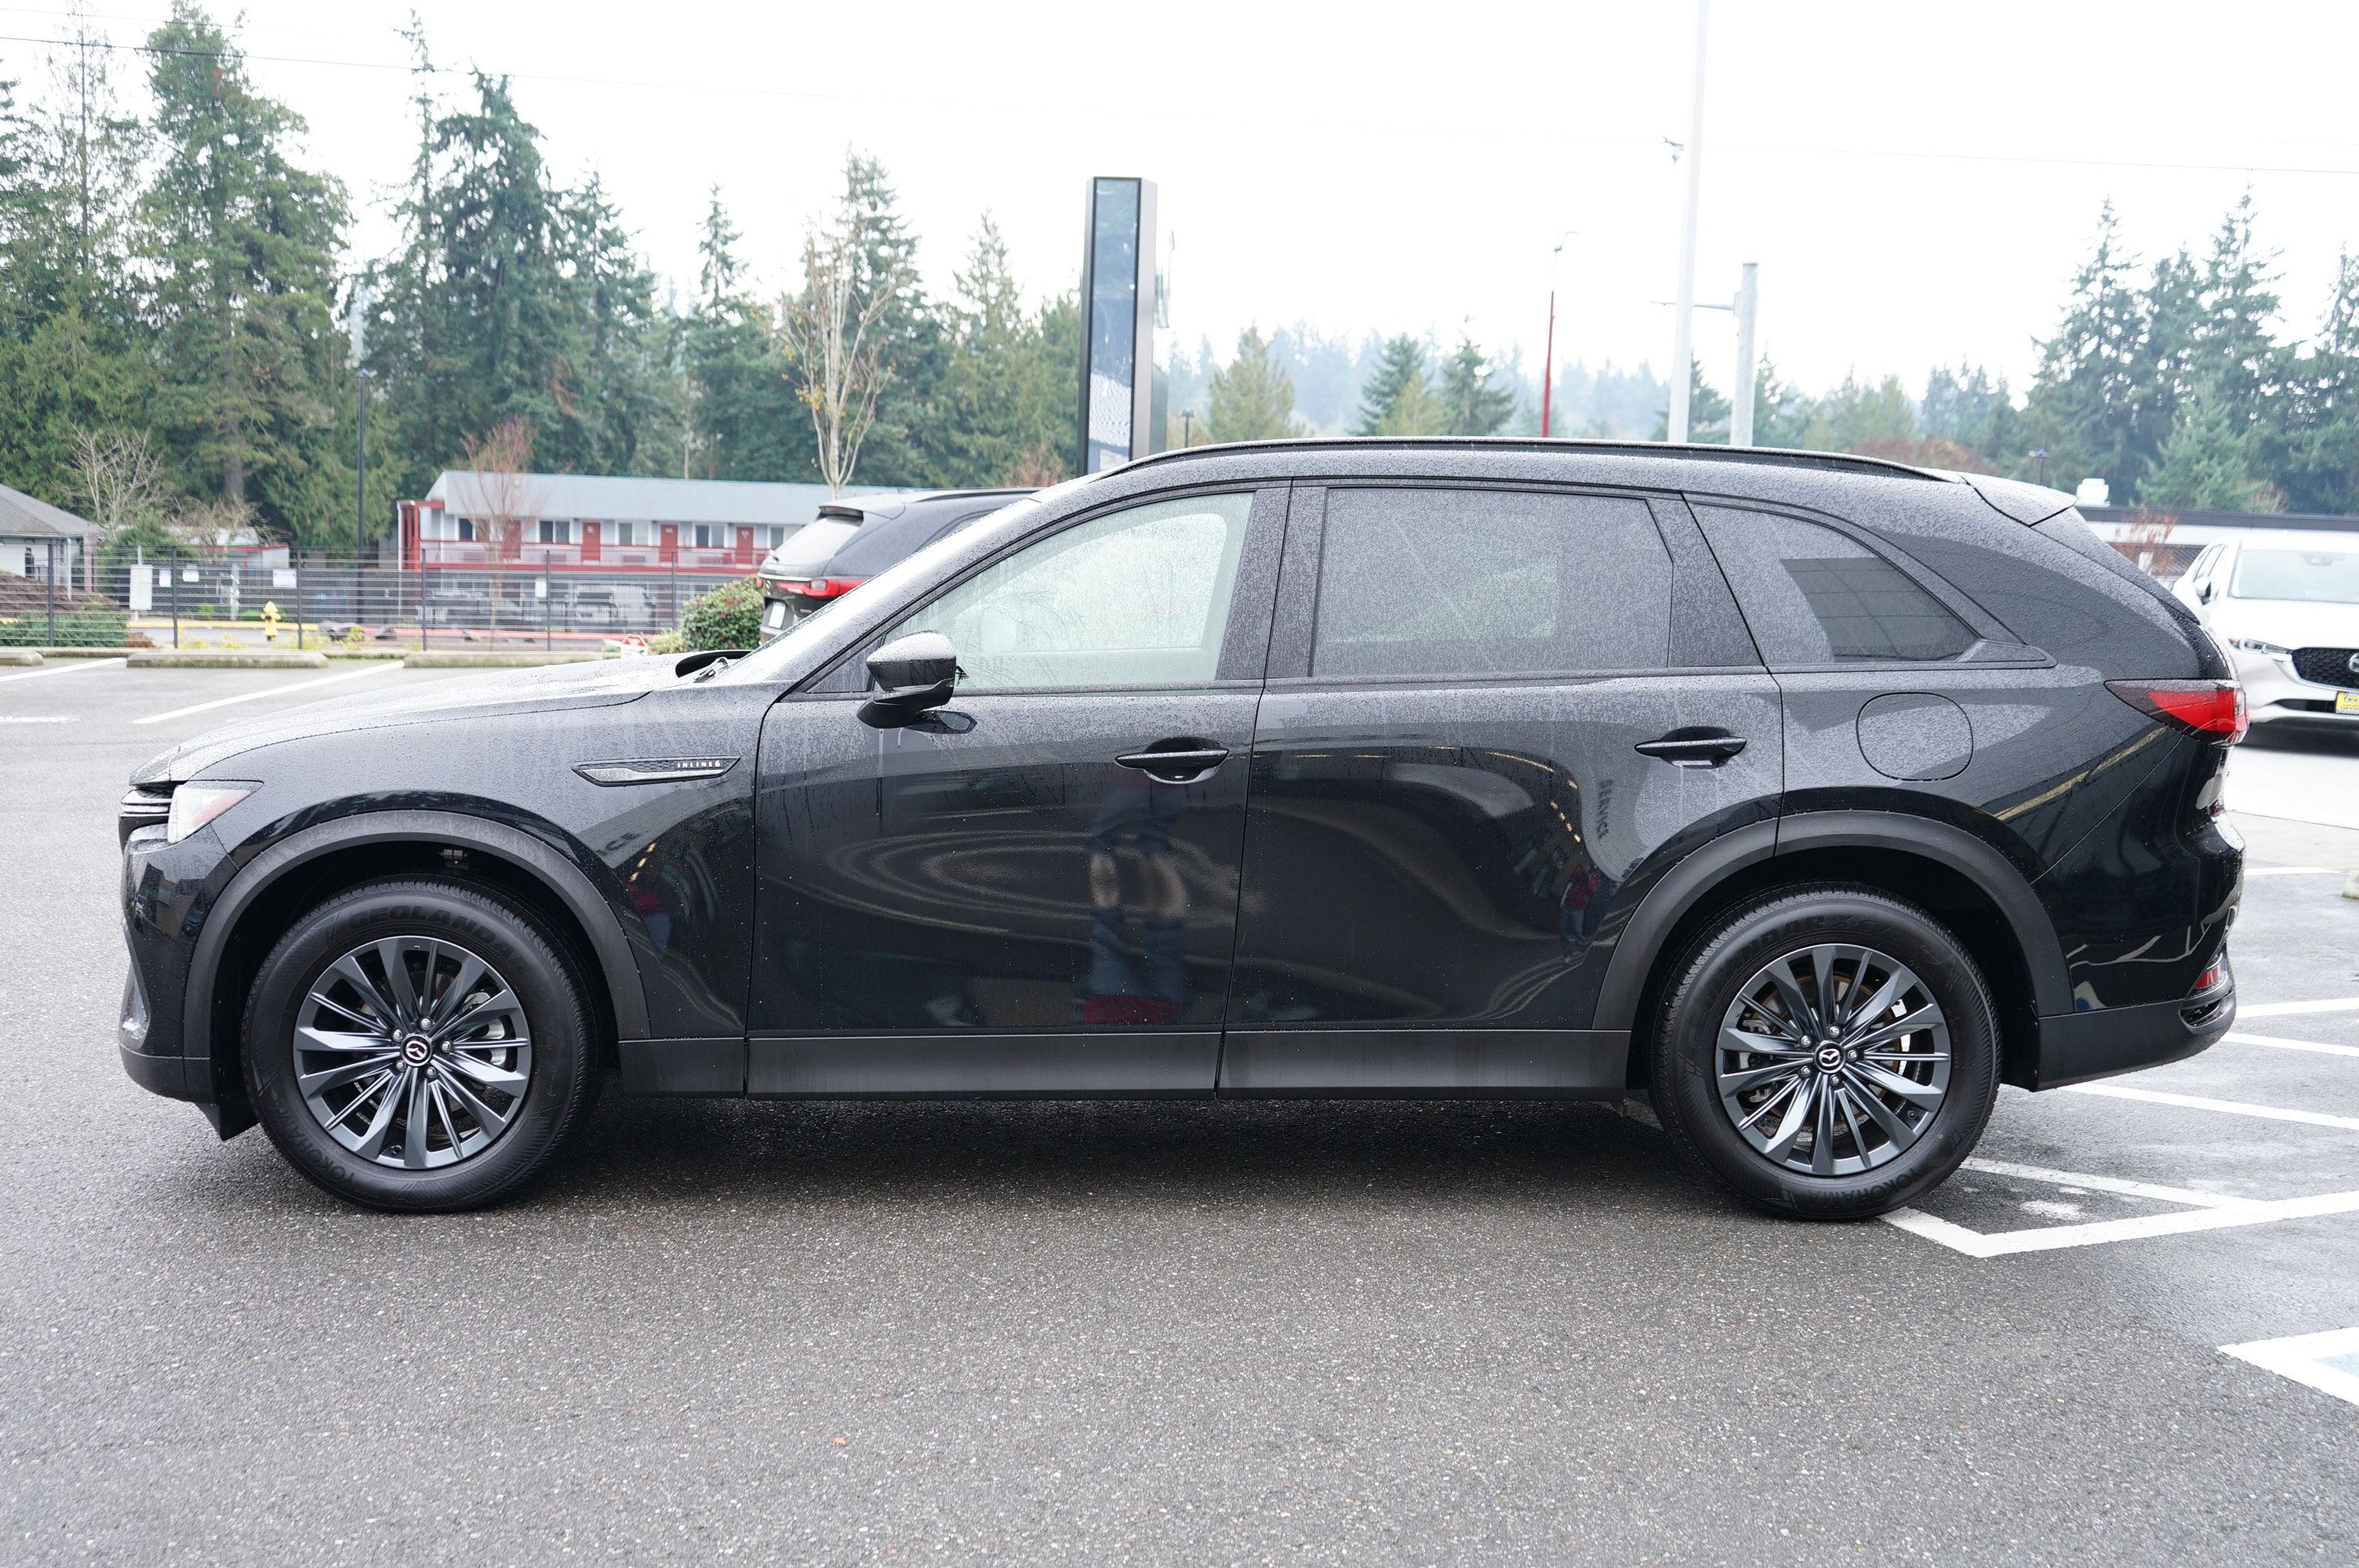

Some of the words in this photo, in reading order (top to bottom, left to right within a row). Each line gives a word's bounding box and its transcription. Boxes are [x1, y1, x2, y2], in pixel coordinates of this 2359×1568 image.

[347, 904, 531, 975] GEOLANDAR
[269, 1104, 357, 1185] YOKOHAMA
[1808, 1167, 1924, 1210] YOKOHAMA
